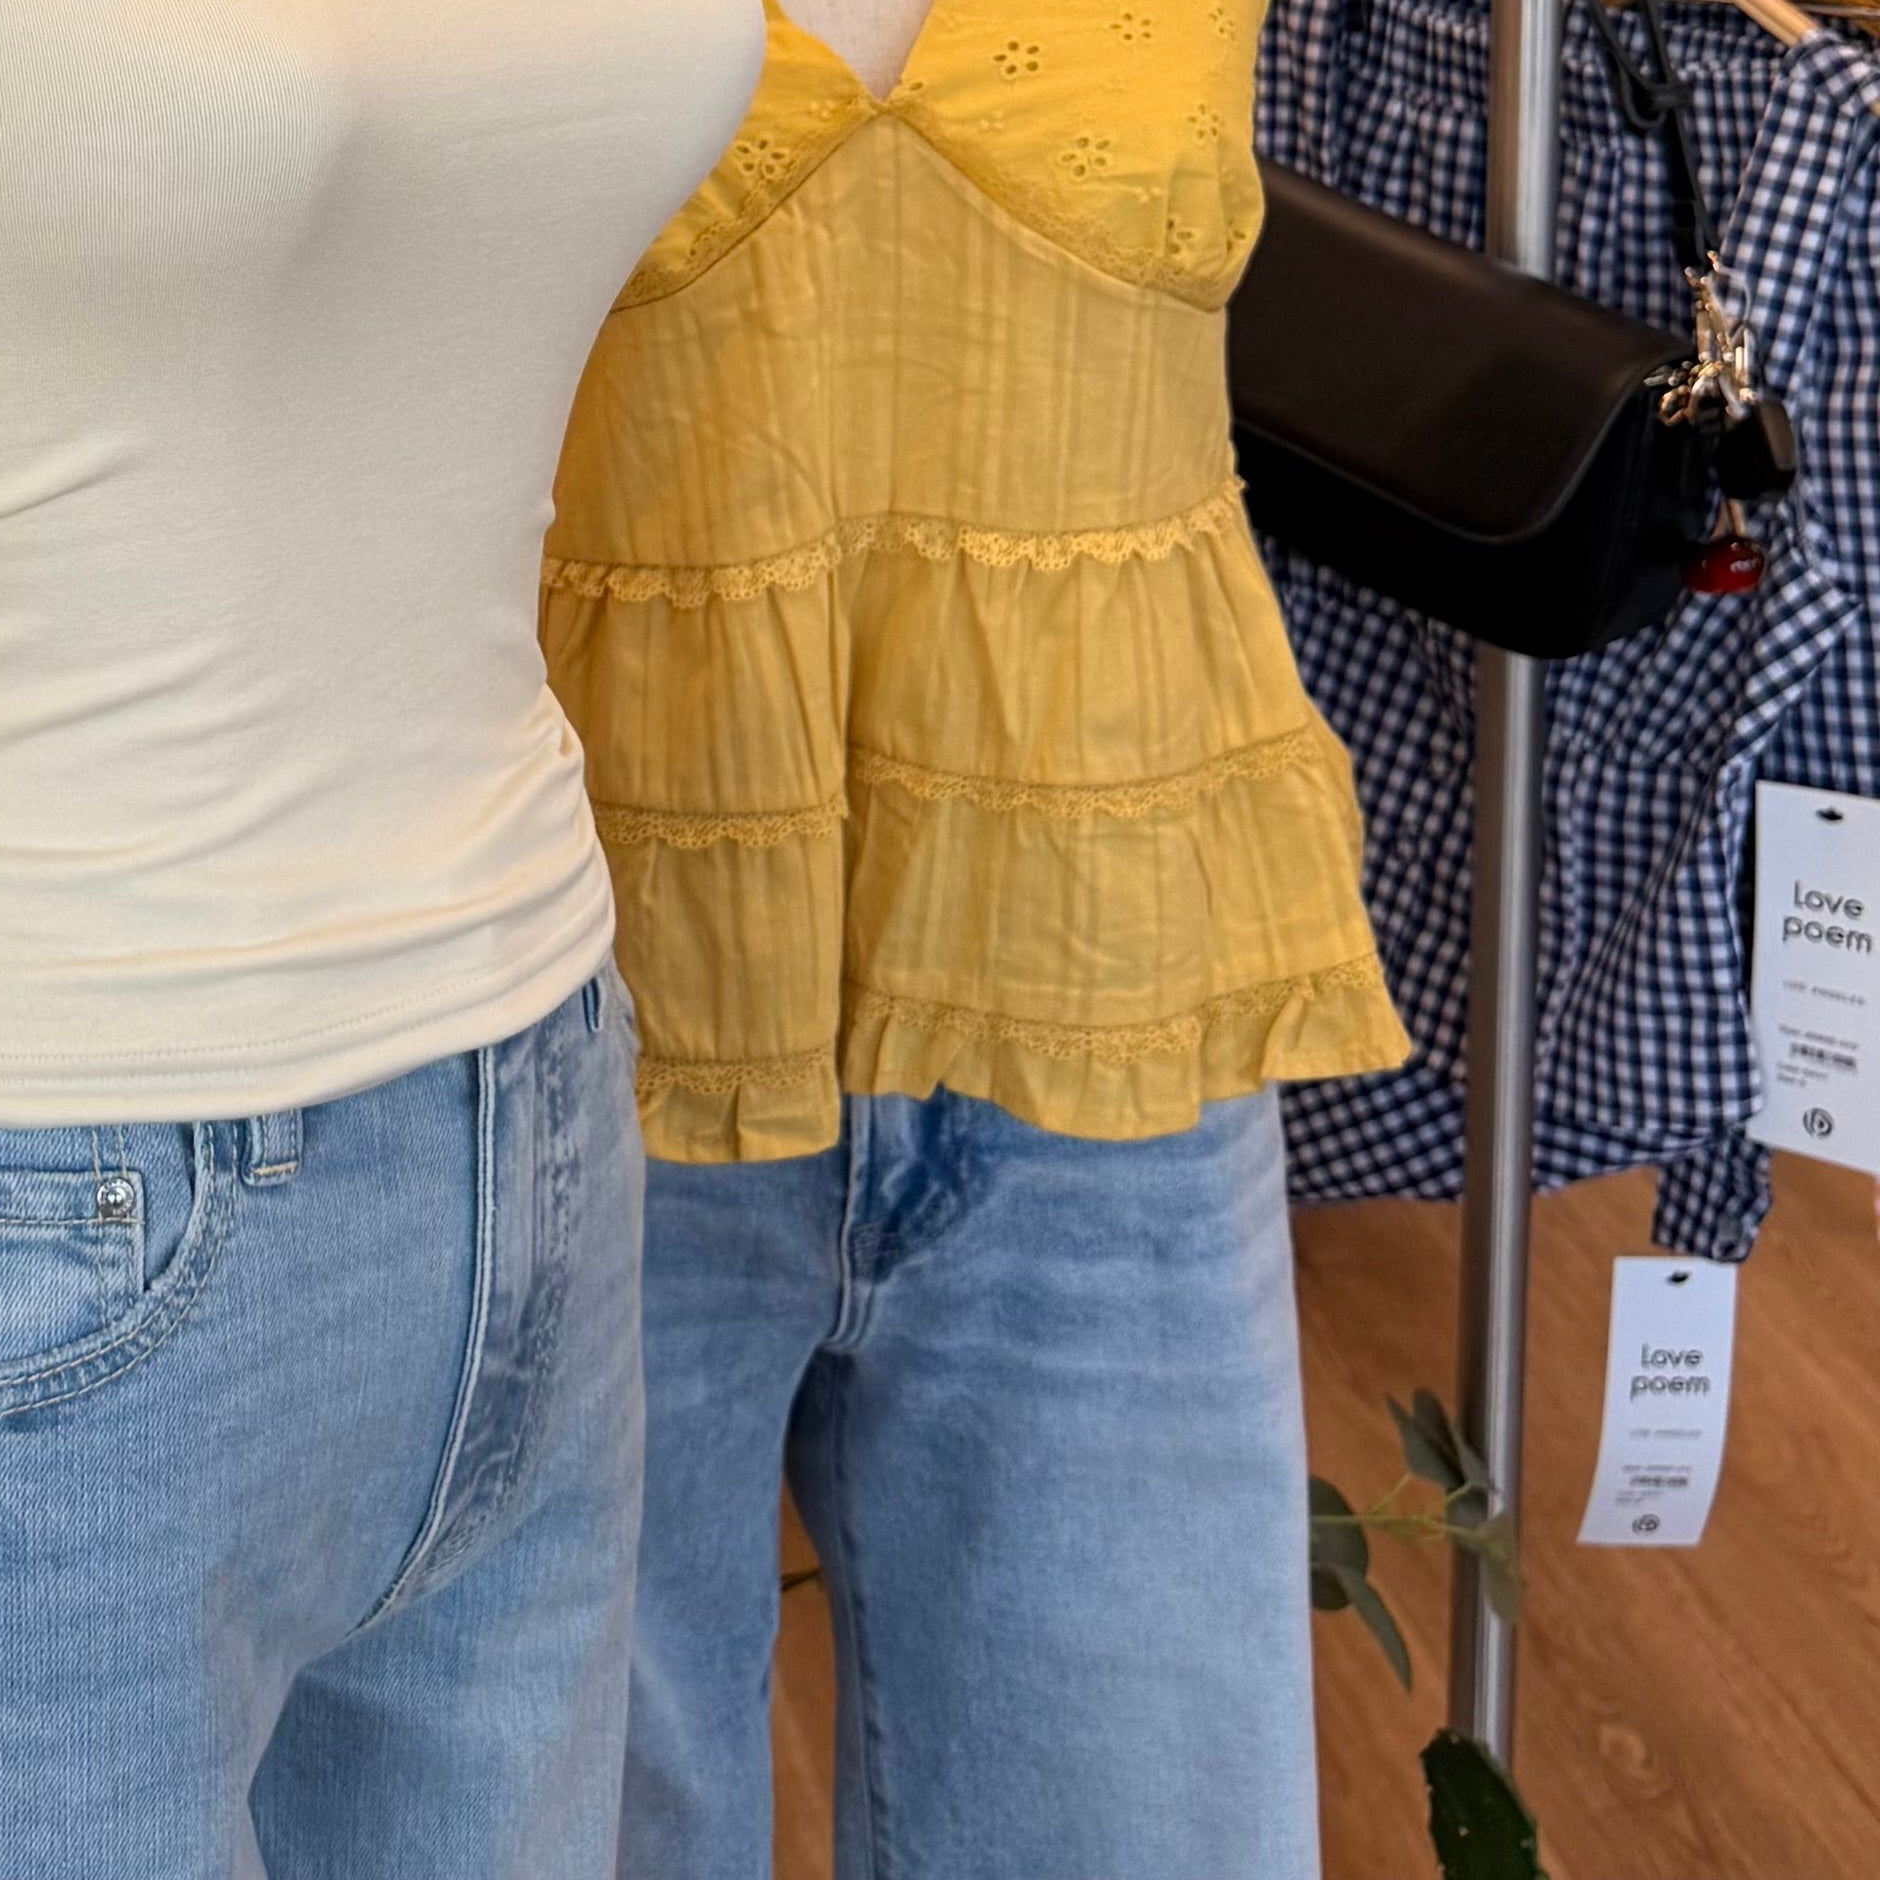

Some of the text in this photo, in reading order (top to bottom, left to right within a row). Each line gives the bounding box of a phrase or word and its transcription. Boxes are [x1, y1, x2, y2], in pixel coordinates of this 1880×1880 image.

[1794, 880, 1864, 919] Love
[1782, 916, 1872, 953] poem
[1641, 1342, 1703, 1368] Love
[1630, 1374, 1710, 1403] poem
